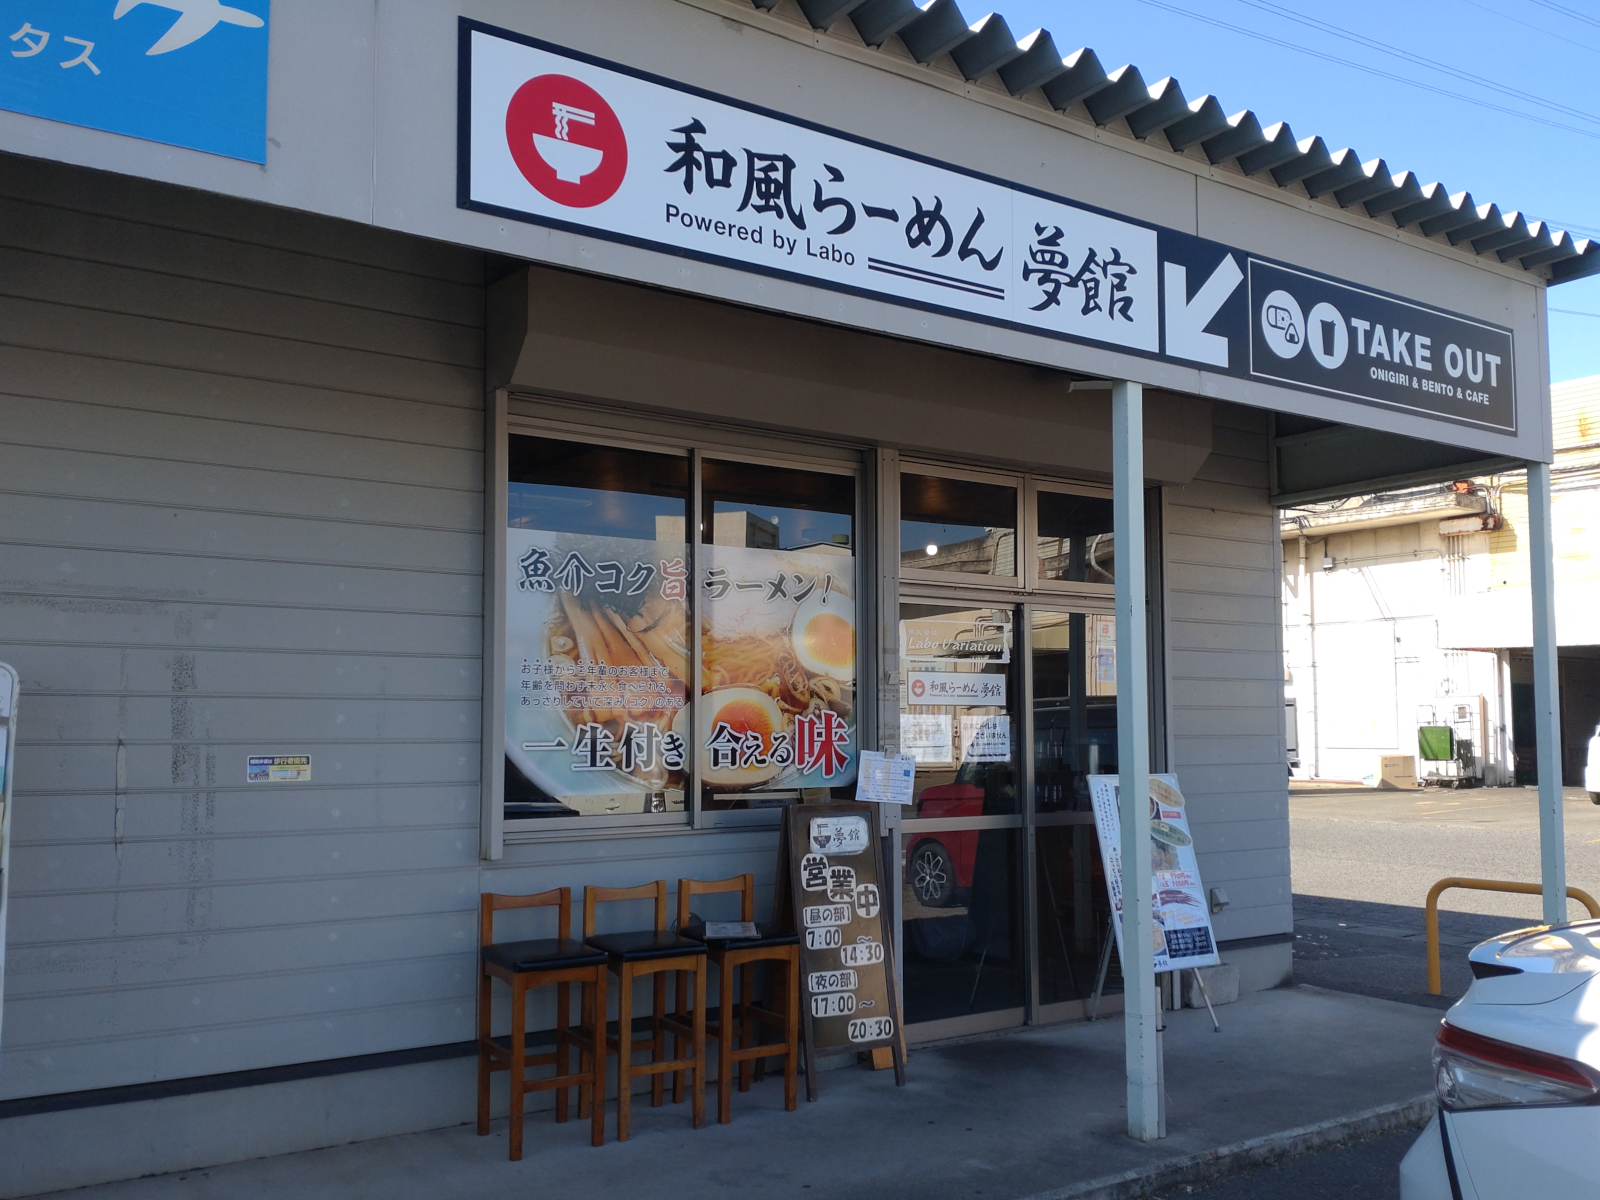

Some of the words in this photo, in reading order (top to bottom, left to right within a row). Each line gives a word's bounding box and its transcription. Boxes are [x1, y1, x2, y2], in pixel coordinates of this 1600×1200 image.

[663, 117, 1004, 271] 和風らーめん
[1022, 222, 1138, 322] 夢館
[665, 203, 763, 245] Powered
[773, 229, 798, 256] by
[806, 237, 855, 266] Labo
[1351, 317, 1433, 372] TAKE
[1444, 343, 1502, 387] OUT
[1370, 366, 1409, 387] ONIGIRI
[1412, 376, 1419, 389] &
[1422, 378, 1454, 397] BENTO
[1457, 387, 1463, 400] &
[1466, 389, 1490, 405] CAFE
[907, 638, 939, 650] Labo
[942, 638, 1002, 653] Variation
[929, 680, 979, 694] 和風らーめん
[833, 827, 860, 848] 夢館
[803, 857, 879, 917] 営業中
[807, 928, 841, 948] 7:00
[842, 944, 883, 964] 14:30
[813, 994, 857, 1015] 17:00
[850, 1019, 893, 1040] 20:30
